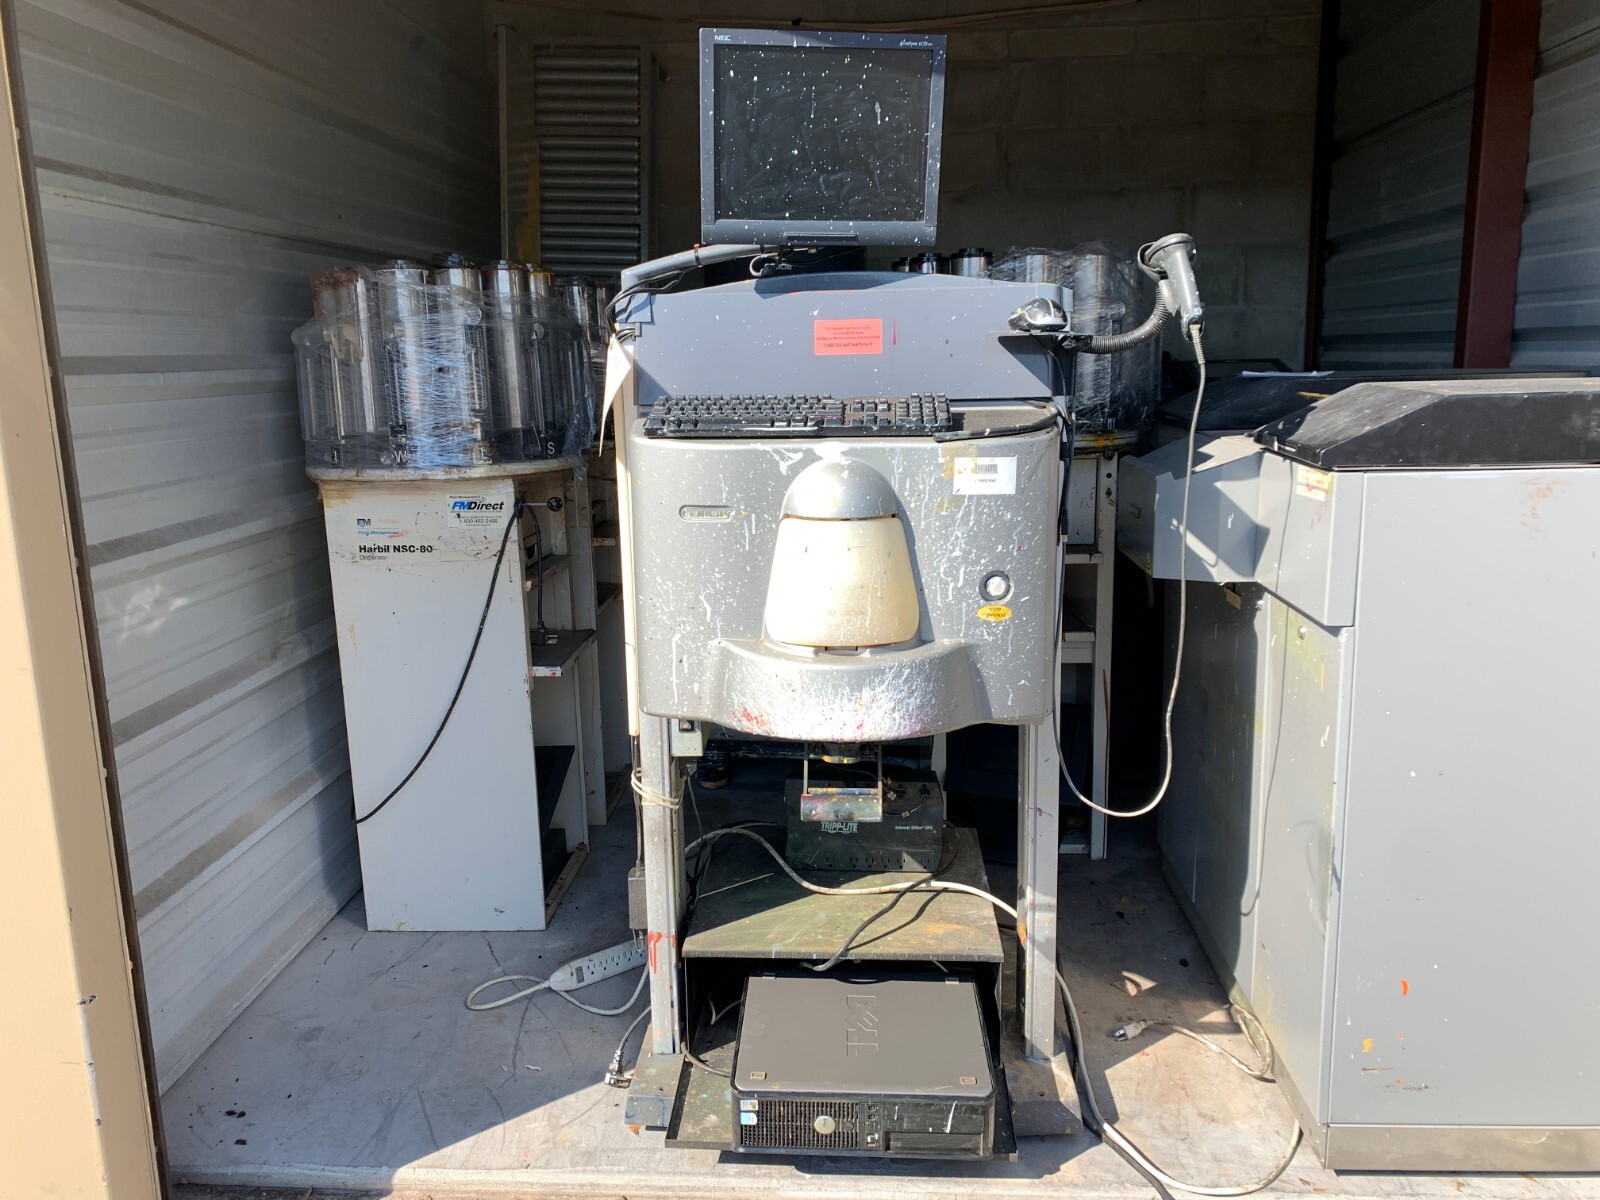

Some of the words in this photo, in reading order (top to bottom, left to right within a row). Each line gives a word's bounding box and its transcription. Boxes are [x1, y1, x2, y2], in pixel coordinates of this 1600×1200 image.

[547, 441, 555, 455] S
[452, 501, 504, 510] FMDirect
[359, 544, 391, 554] Harbil
[392, 544, 434, 554] NSC-80
[844, 994, 879, 1057] DELL
